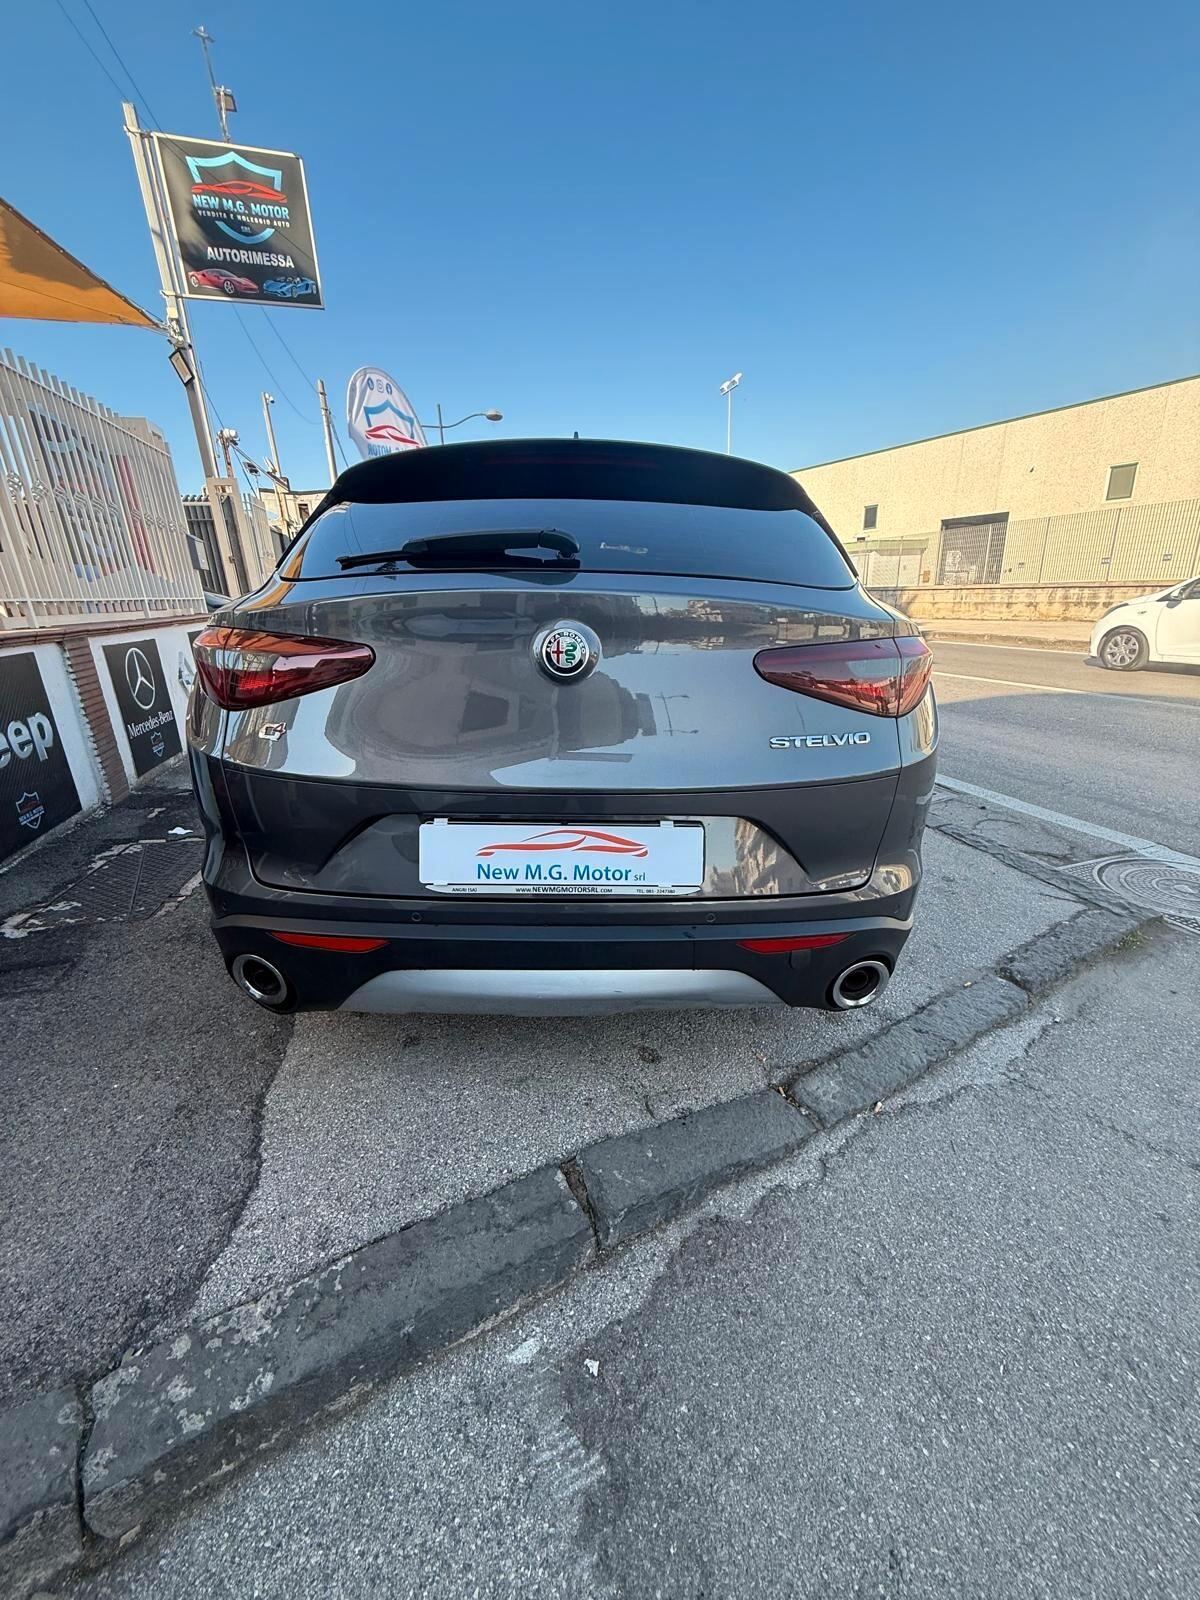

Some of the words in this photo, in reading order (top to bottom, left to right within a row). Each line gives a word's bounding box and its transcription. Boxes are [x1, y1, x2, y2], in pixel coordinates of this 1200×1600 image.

[192, 194, 219, 210] NEW
[222, 198, 248, 214] M.G.
[250, 202, 290, 219] MOTOR
[197, 209, 227, 219] VENDITA
[237, 214, 271, 225] NOLEGGIO
[273, 220, 290, 228] AUTO
[207, 246, 295, 268] AUTORIMESSA
[546, 634, 561, 653] ALFA
[563, 631, 586, 654] ROMEO
[127, 709, 175, 740] Mercedes-Benz
[769, 731, 871, 749] STELVIO
[476, 863, 519, 881] New
[524, 864, 568, 882] M.G.
[573, 864, 632, 882] Motor
[633, 872, 646, 882] srl
